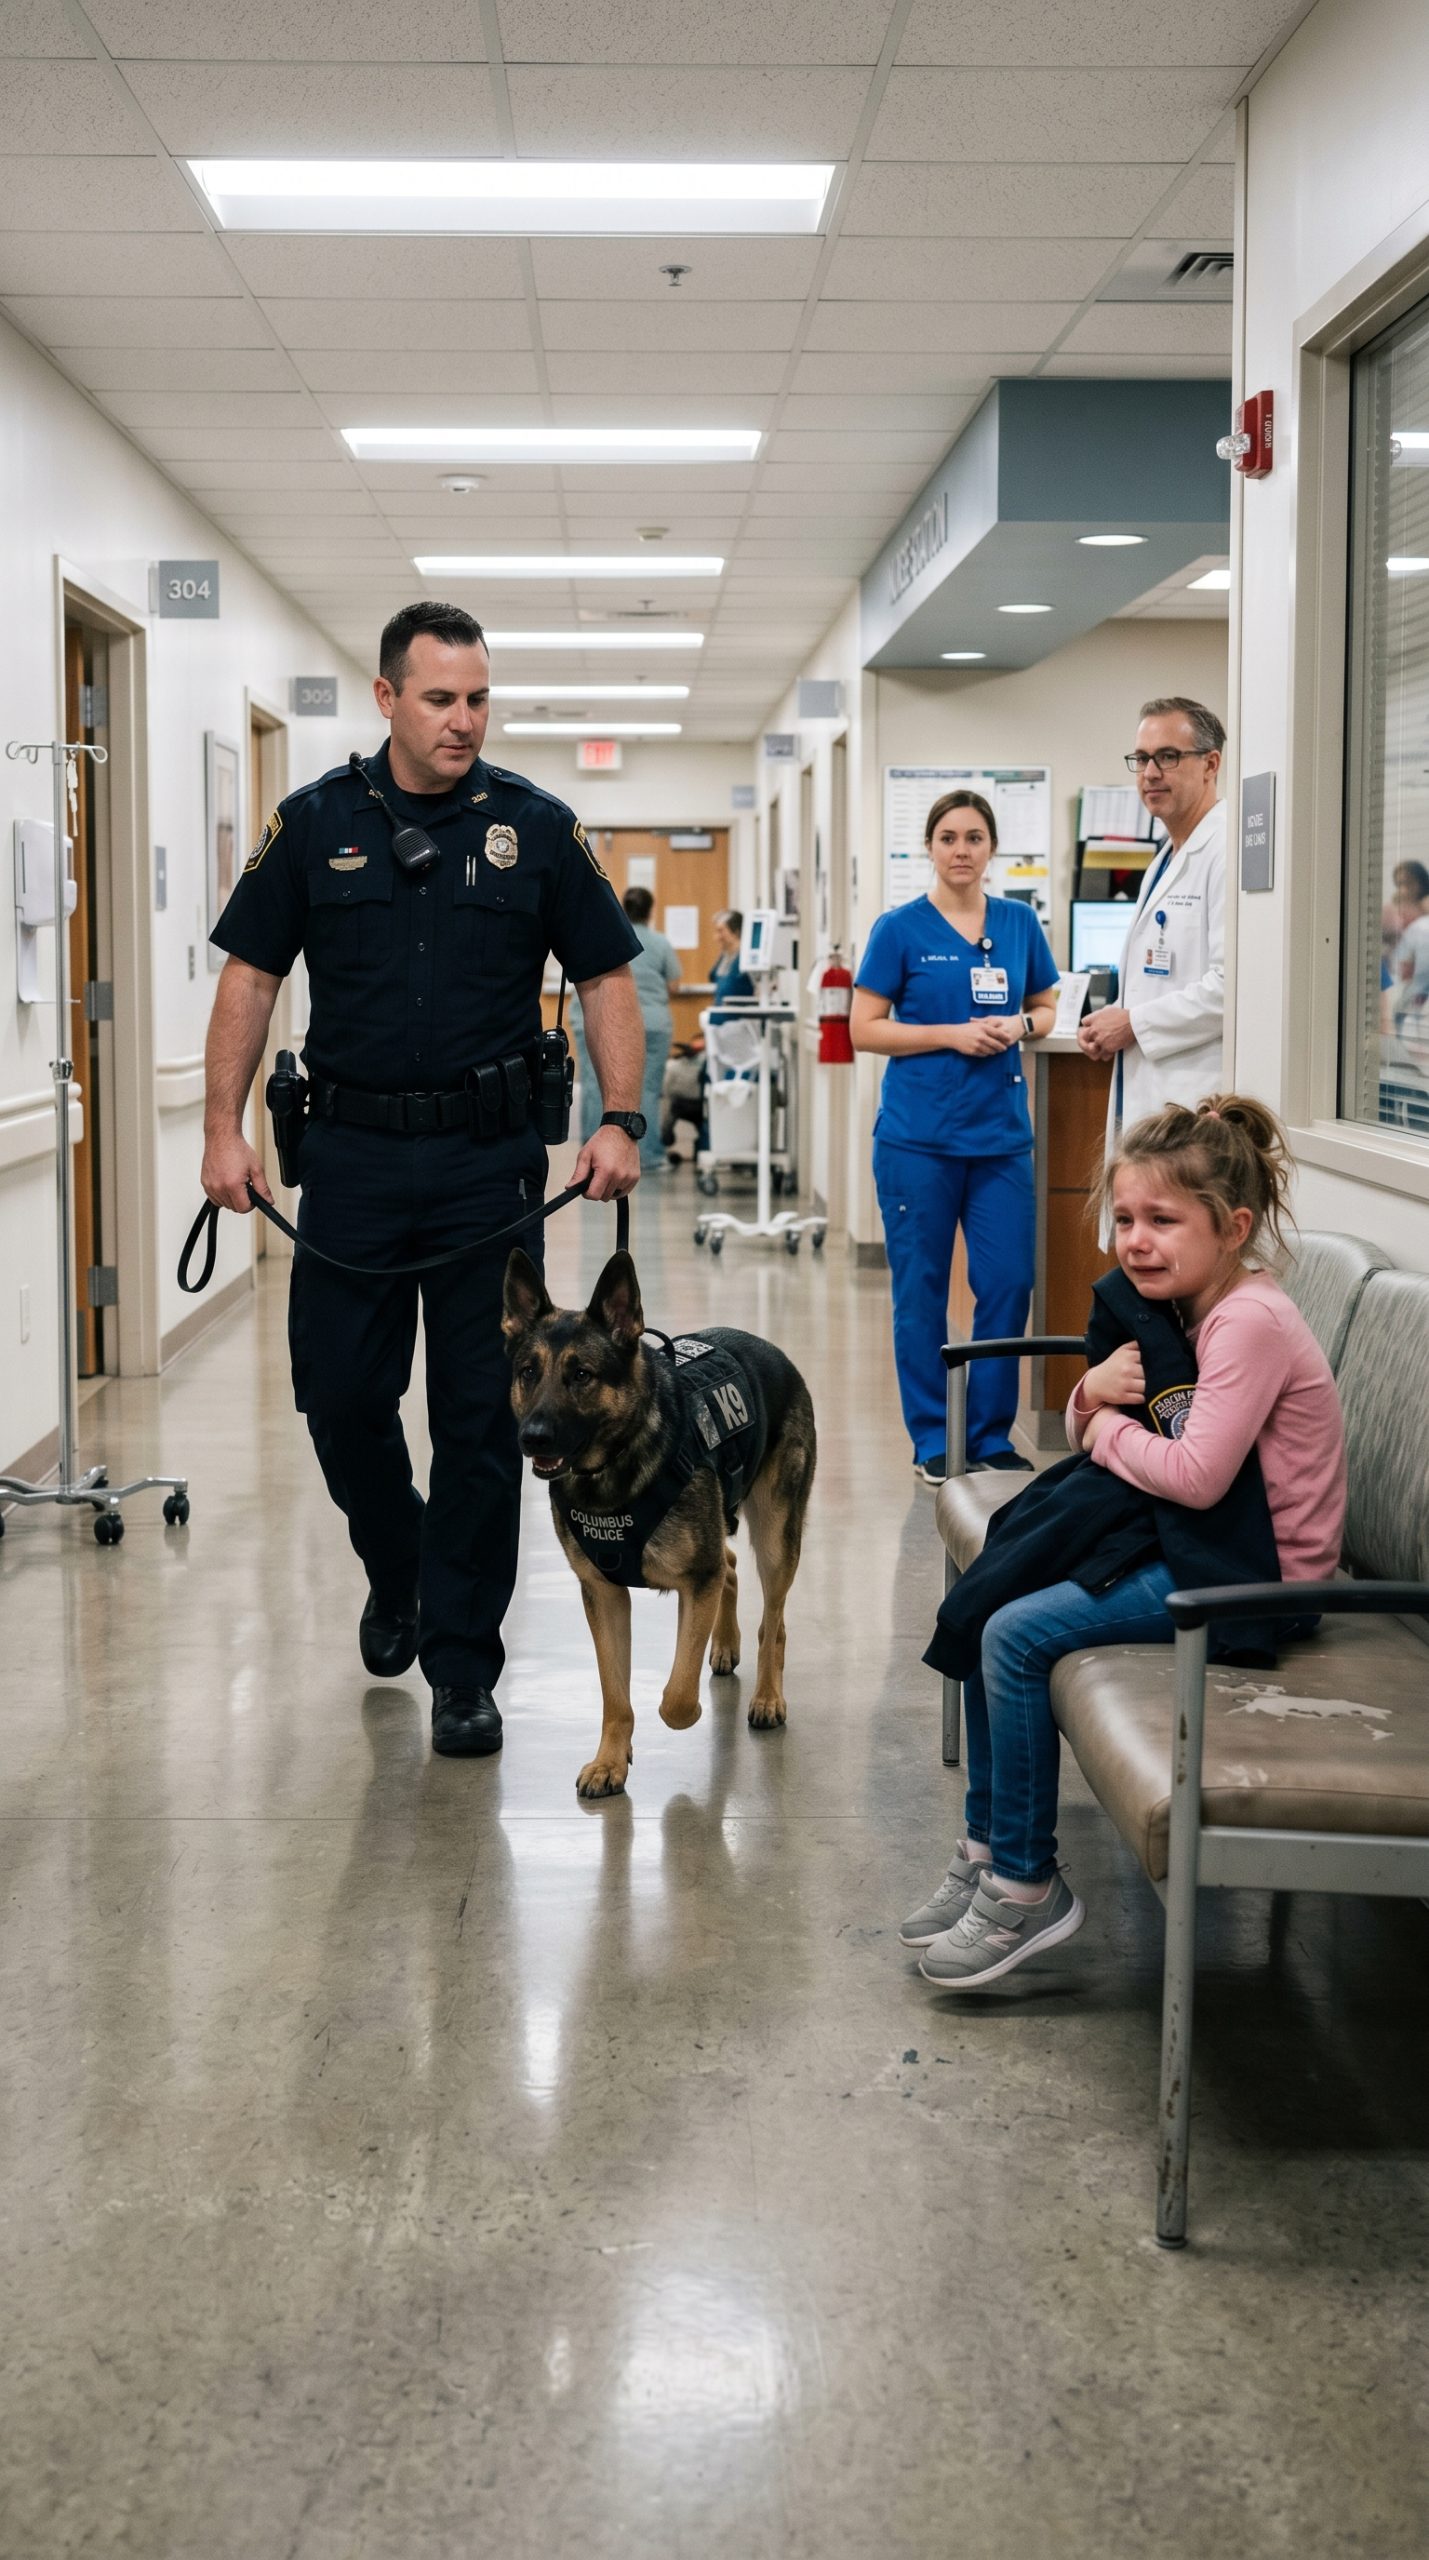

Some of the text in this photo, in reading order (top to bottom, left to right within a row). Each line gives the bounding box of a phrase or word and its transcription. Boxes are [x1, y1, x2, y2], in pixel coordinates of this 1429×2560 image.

[168, 579, 211, 600] 304
[301, 689, 333, 704] 305
[711, 1382, 749, 1431] K9
[570, 1508, 634, 1529] COLUMBUS
[582, 1524, 625, 1541] POLICE
